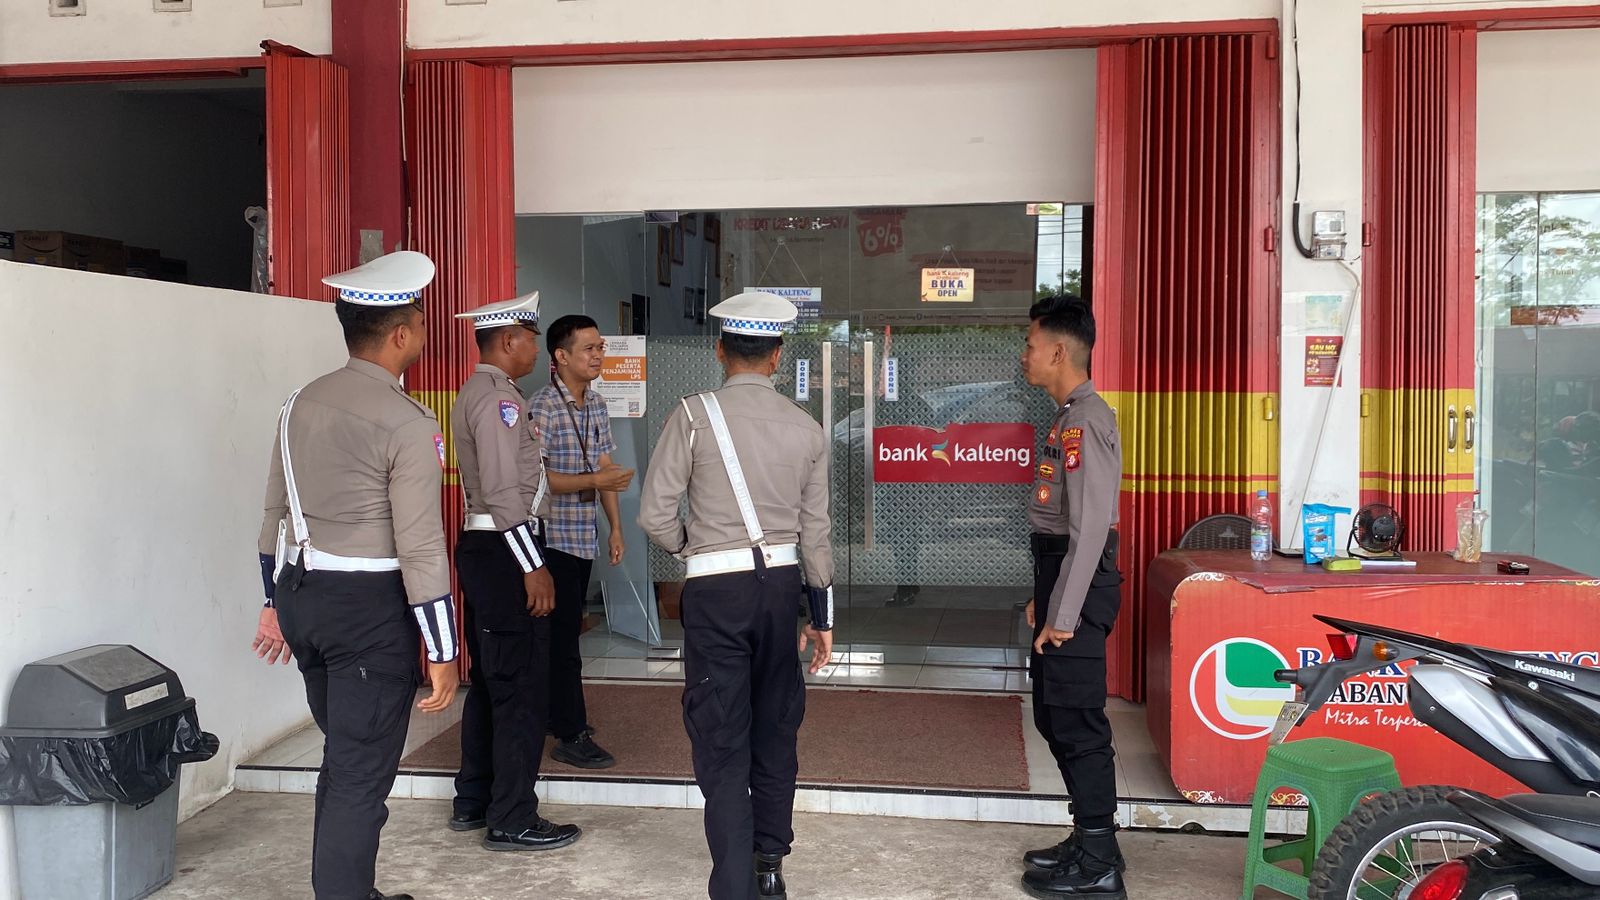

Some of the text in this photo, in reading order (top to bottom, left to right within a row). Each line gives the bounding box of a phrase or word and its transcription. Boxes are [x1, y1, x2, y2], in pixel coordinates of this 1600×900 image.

[931, 280, 964, 288] BUKA
[879, 442, 1030, 467] bank kalteng
[1514, 659, 1576, 682] Kawasaki
[1323, 681, 1408, 705] ABAN
[1325, 708, 1370, 725] Mitra
